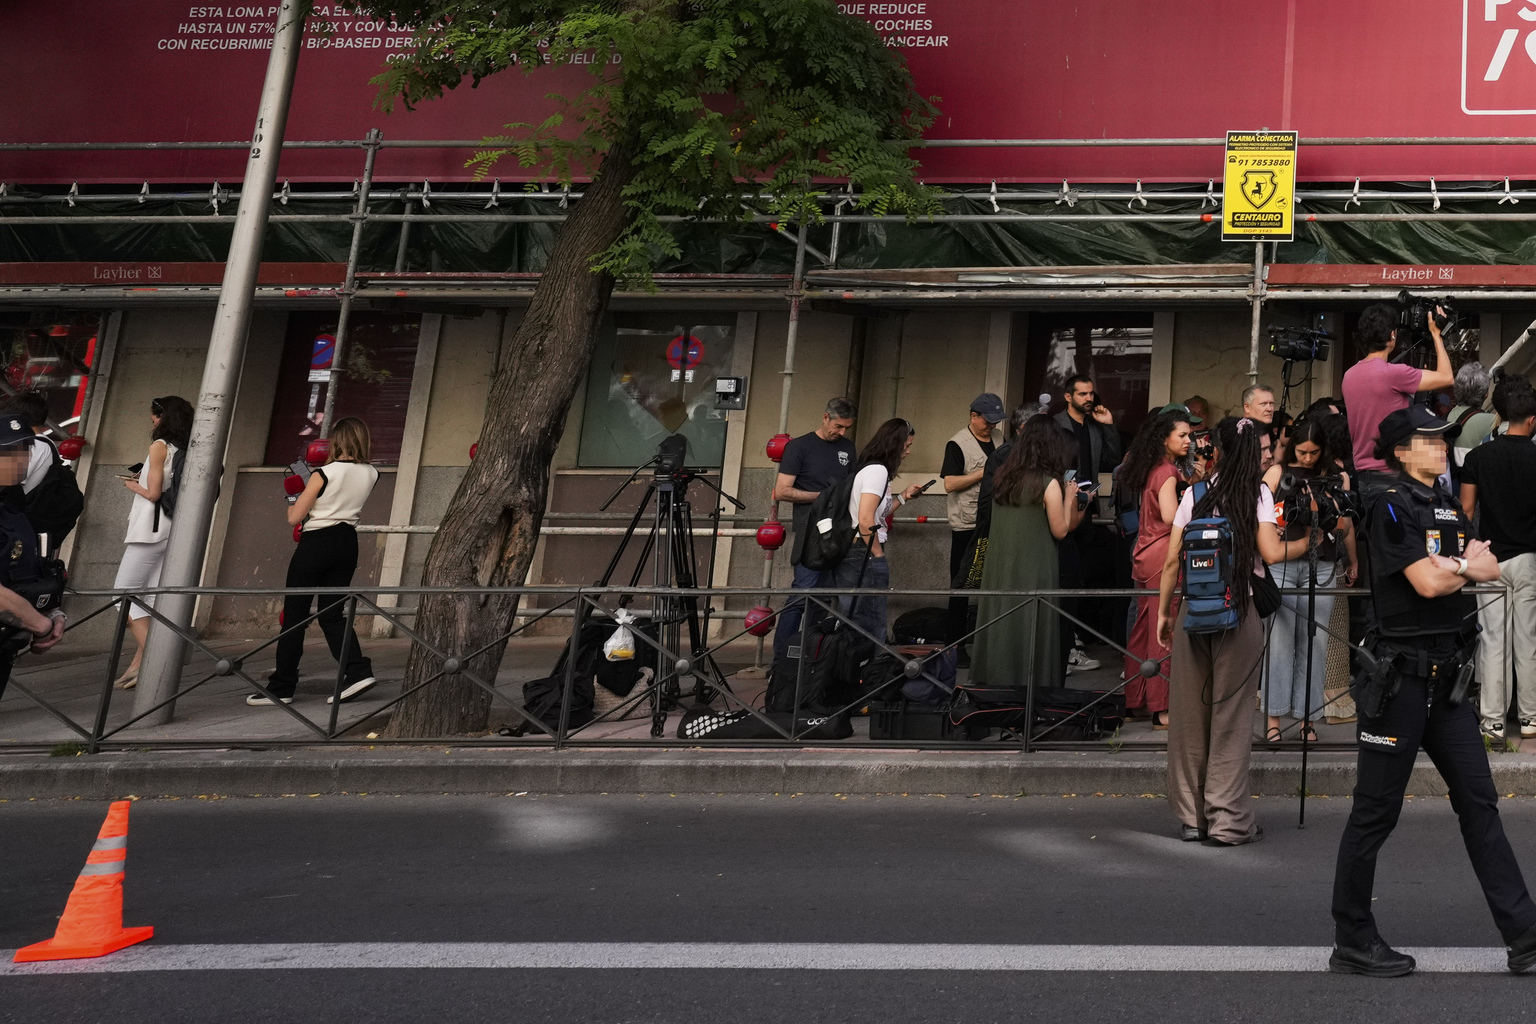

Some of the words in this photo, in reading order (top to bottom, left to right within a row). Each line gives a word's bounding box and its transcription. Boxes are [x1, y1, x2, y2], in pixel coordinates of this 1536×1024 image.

[189, 6, 224, 18] ESTA
[226, 6, 264, 18] LONA
[333, 6, 351, 17] EL
[837, 3, 866, 15] QUE
[869, 3, 927, 15] REDUCE
[178, 22, 223, 34] HASTA
[226, 22, 246, 34] UN
[249, 22, 276, 34] 57%
[343, 21, 353, 32] Y
[355, 21, 386, 33] COV
[874, 19, 933, 31] COCHES
[157, 38, 188, 50] CON
[190, 38, 303, 50] RECUBRIMIE
[306, 37, 382, 49] BIO-BASED
[251, 117, 264, 159] 102
[1234, 213, 1282, 221] CENTAURO
[93, 265, 143, 280] Layher
[1381, 267, 1433, 281] Layher
[1192, 558, 1214, 568] LiveU
